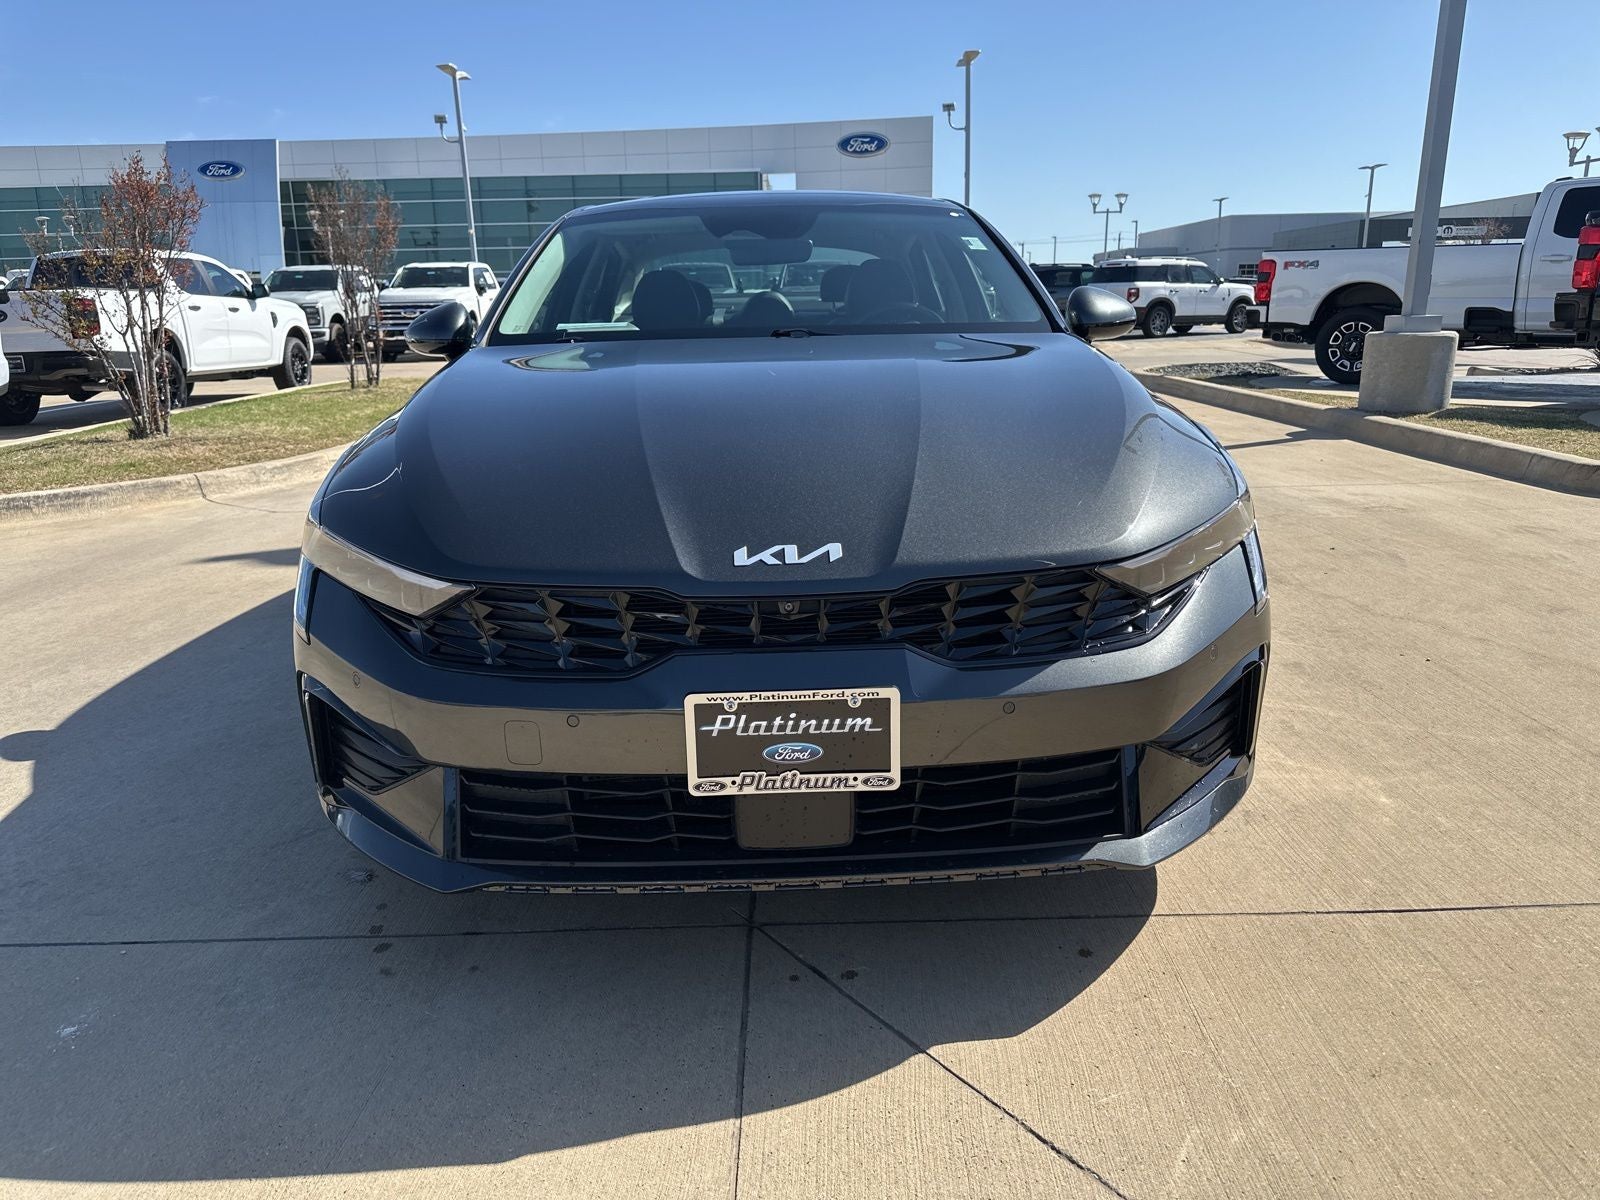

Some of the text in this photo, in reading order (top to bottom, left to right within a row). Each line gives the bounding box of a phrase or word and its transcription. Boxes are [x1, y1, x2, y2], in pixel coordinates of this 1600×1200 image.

[846, 137, 878, 152] Ford
[206, 163, 233, 176] Ford
[706, 690, 880, 702] www.PlatinumFord.com
[700, 712, 883, 737] Platinum
[774, 746, 811, 760] Ford
[699, 782, 721, 792] Ford
[737, 770, 859, 793] Platinum
[867, 777, 889, 787] Ford
